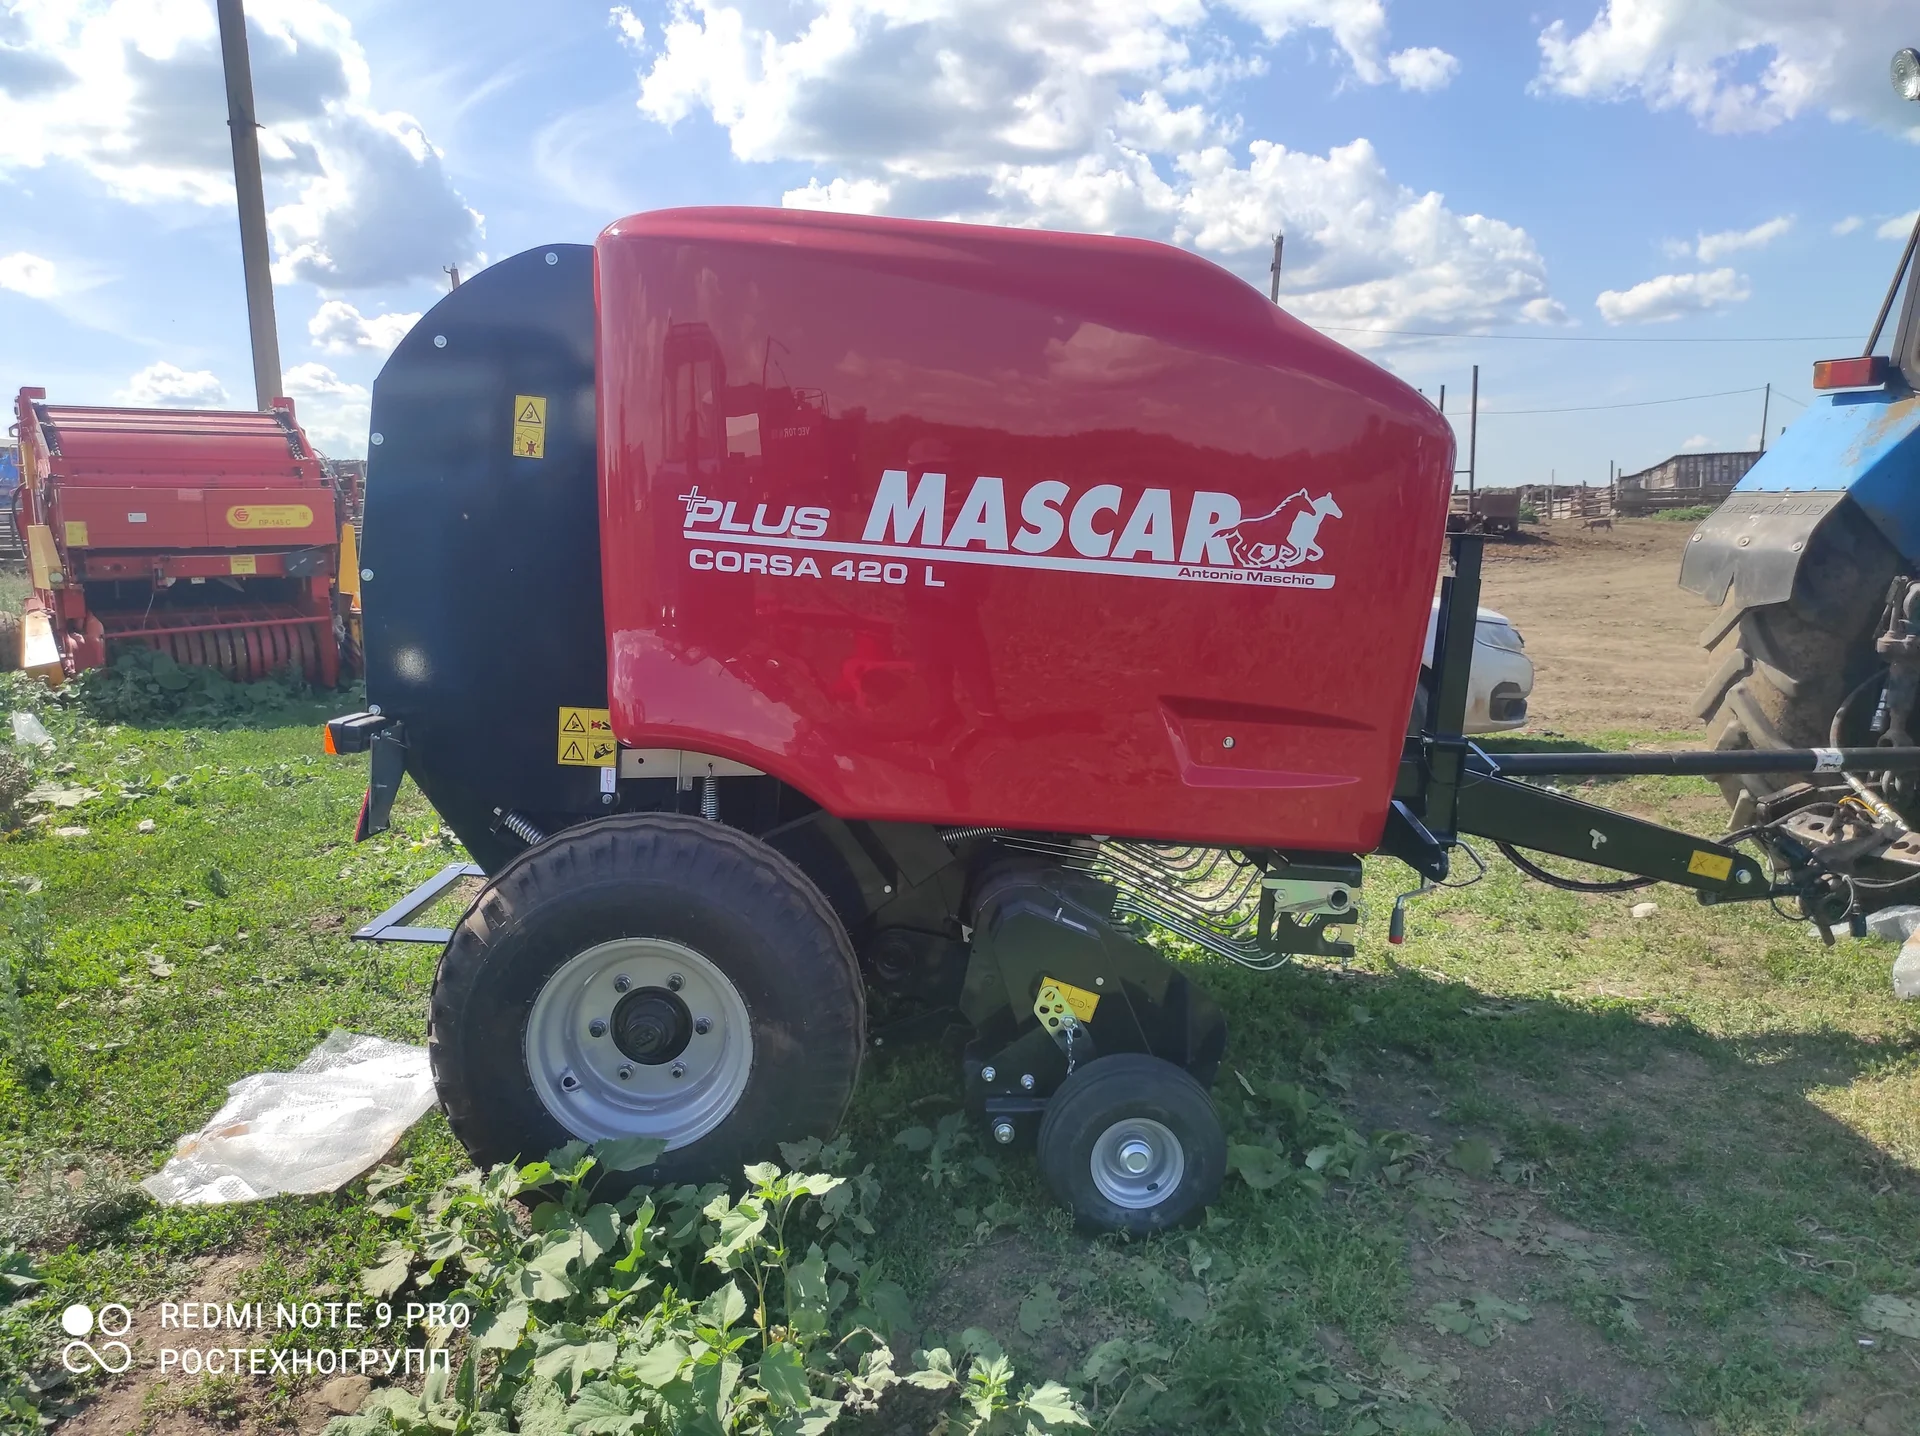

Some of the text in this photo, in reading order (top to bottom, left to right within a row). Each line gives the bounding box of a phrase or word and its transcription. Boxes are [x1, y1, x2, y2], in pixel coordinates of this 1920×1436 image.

[861, 469, 1242, 565] MASCAR
[1720, 503, 1829, 516] BELARUS
[689, 548, 946, 587] CORSA 420 L
[1178, 567, 1315, 586] Antonio Maschio
